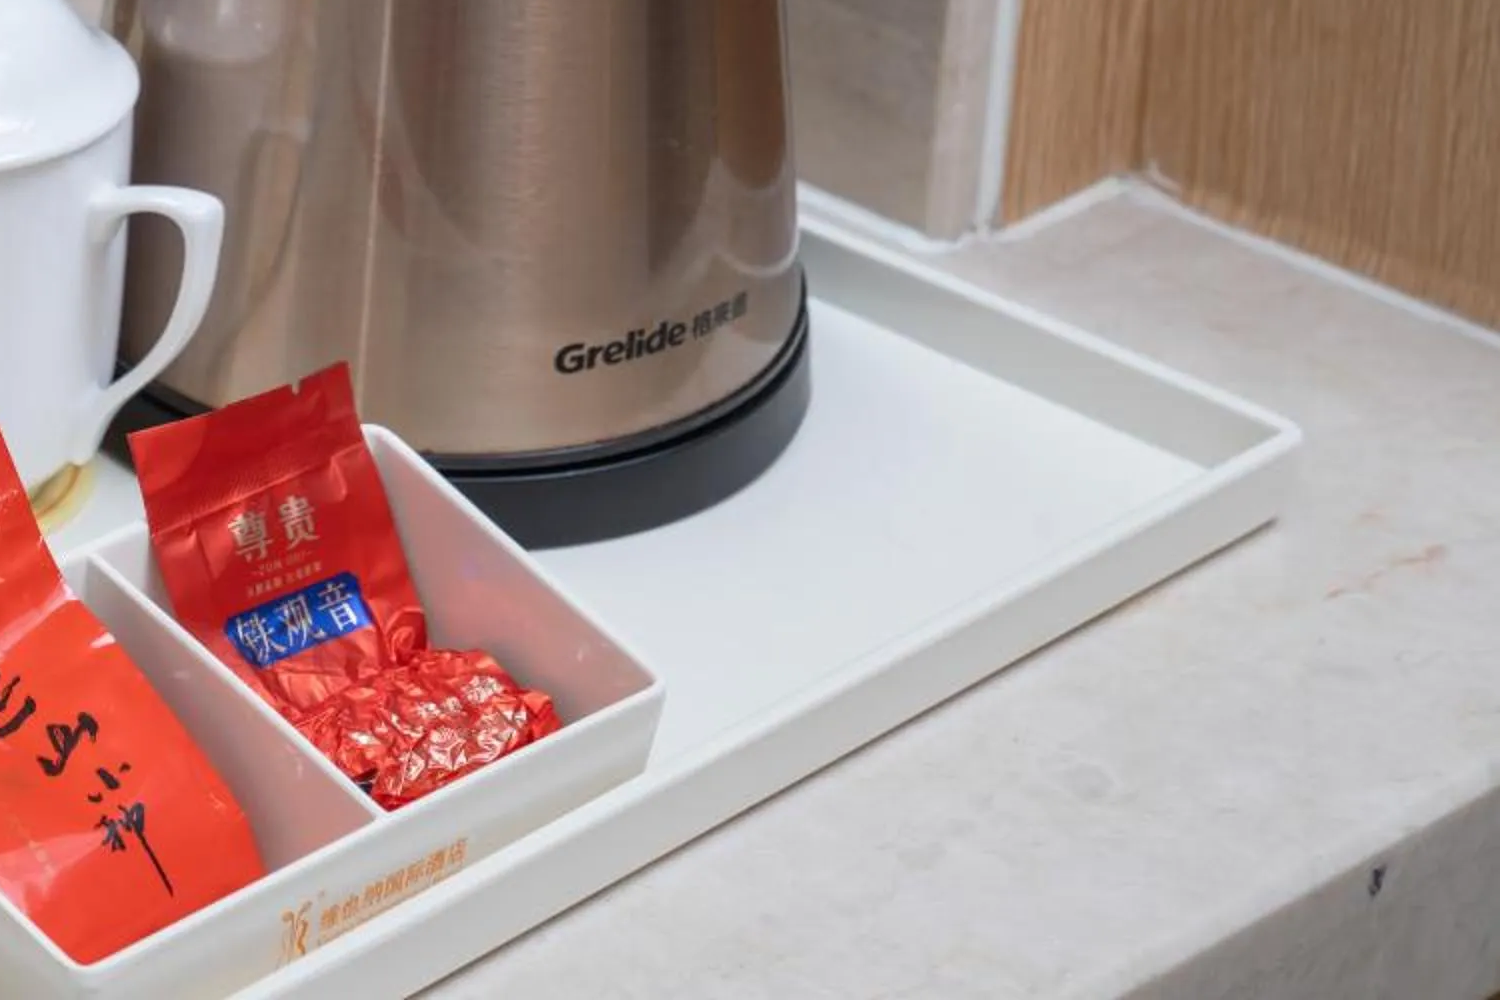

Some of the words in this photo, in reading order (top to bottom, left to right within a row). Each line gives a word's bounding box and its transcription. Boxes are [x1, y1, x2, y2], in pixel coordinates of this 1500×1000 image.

[555, 321, 686, 374] Grelide
[228, 494, 321, 562] 尊贵
[236, 581, 358, 663] 铁观音
